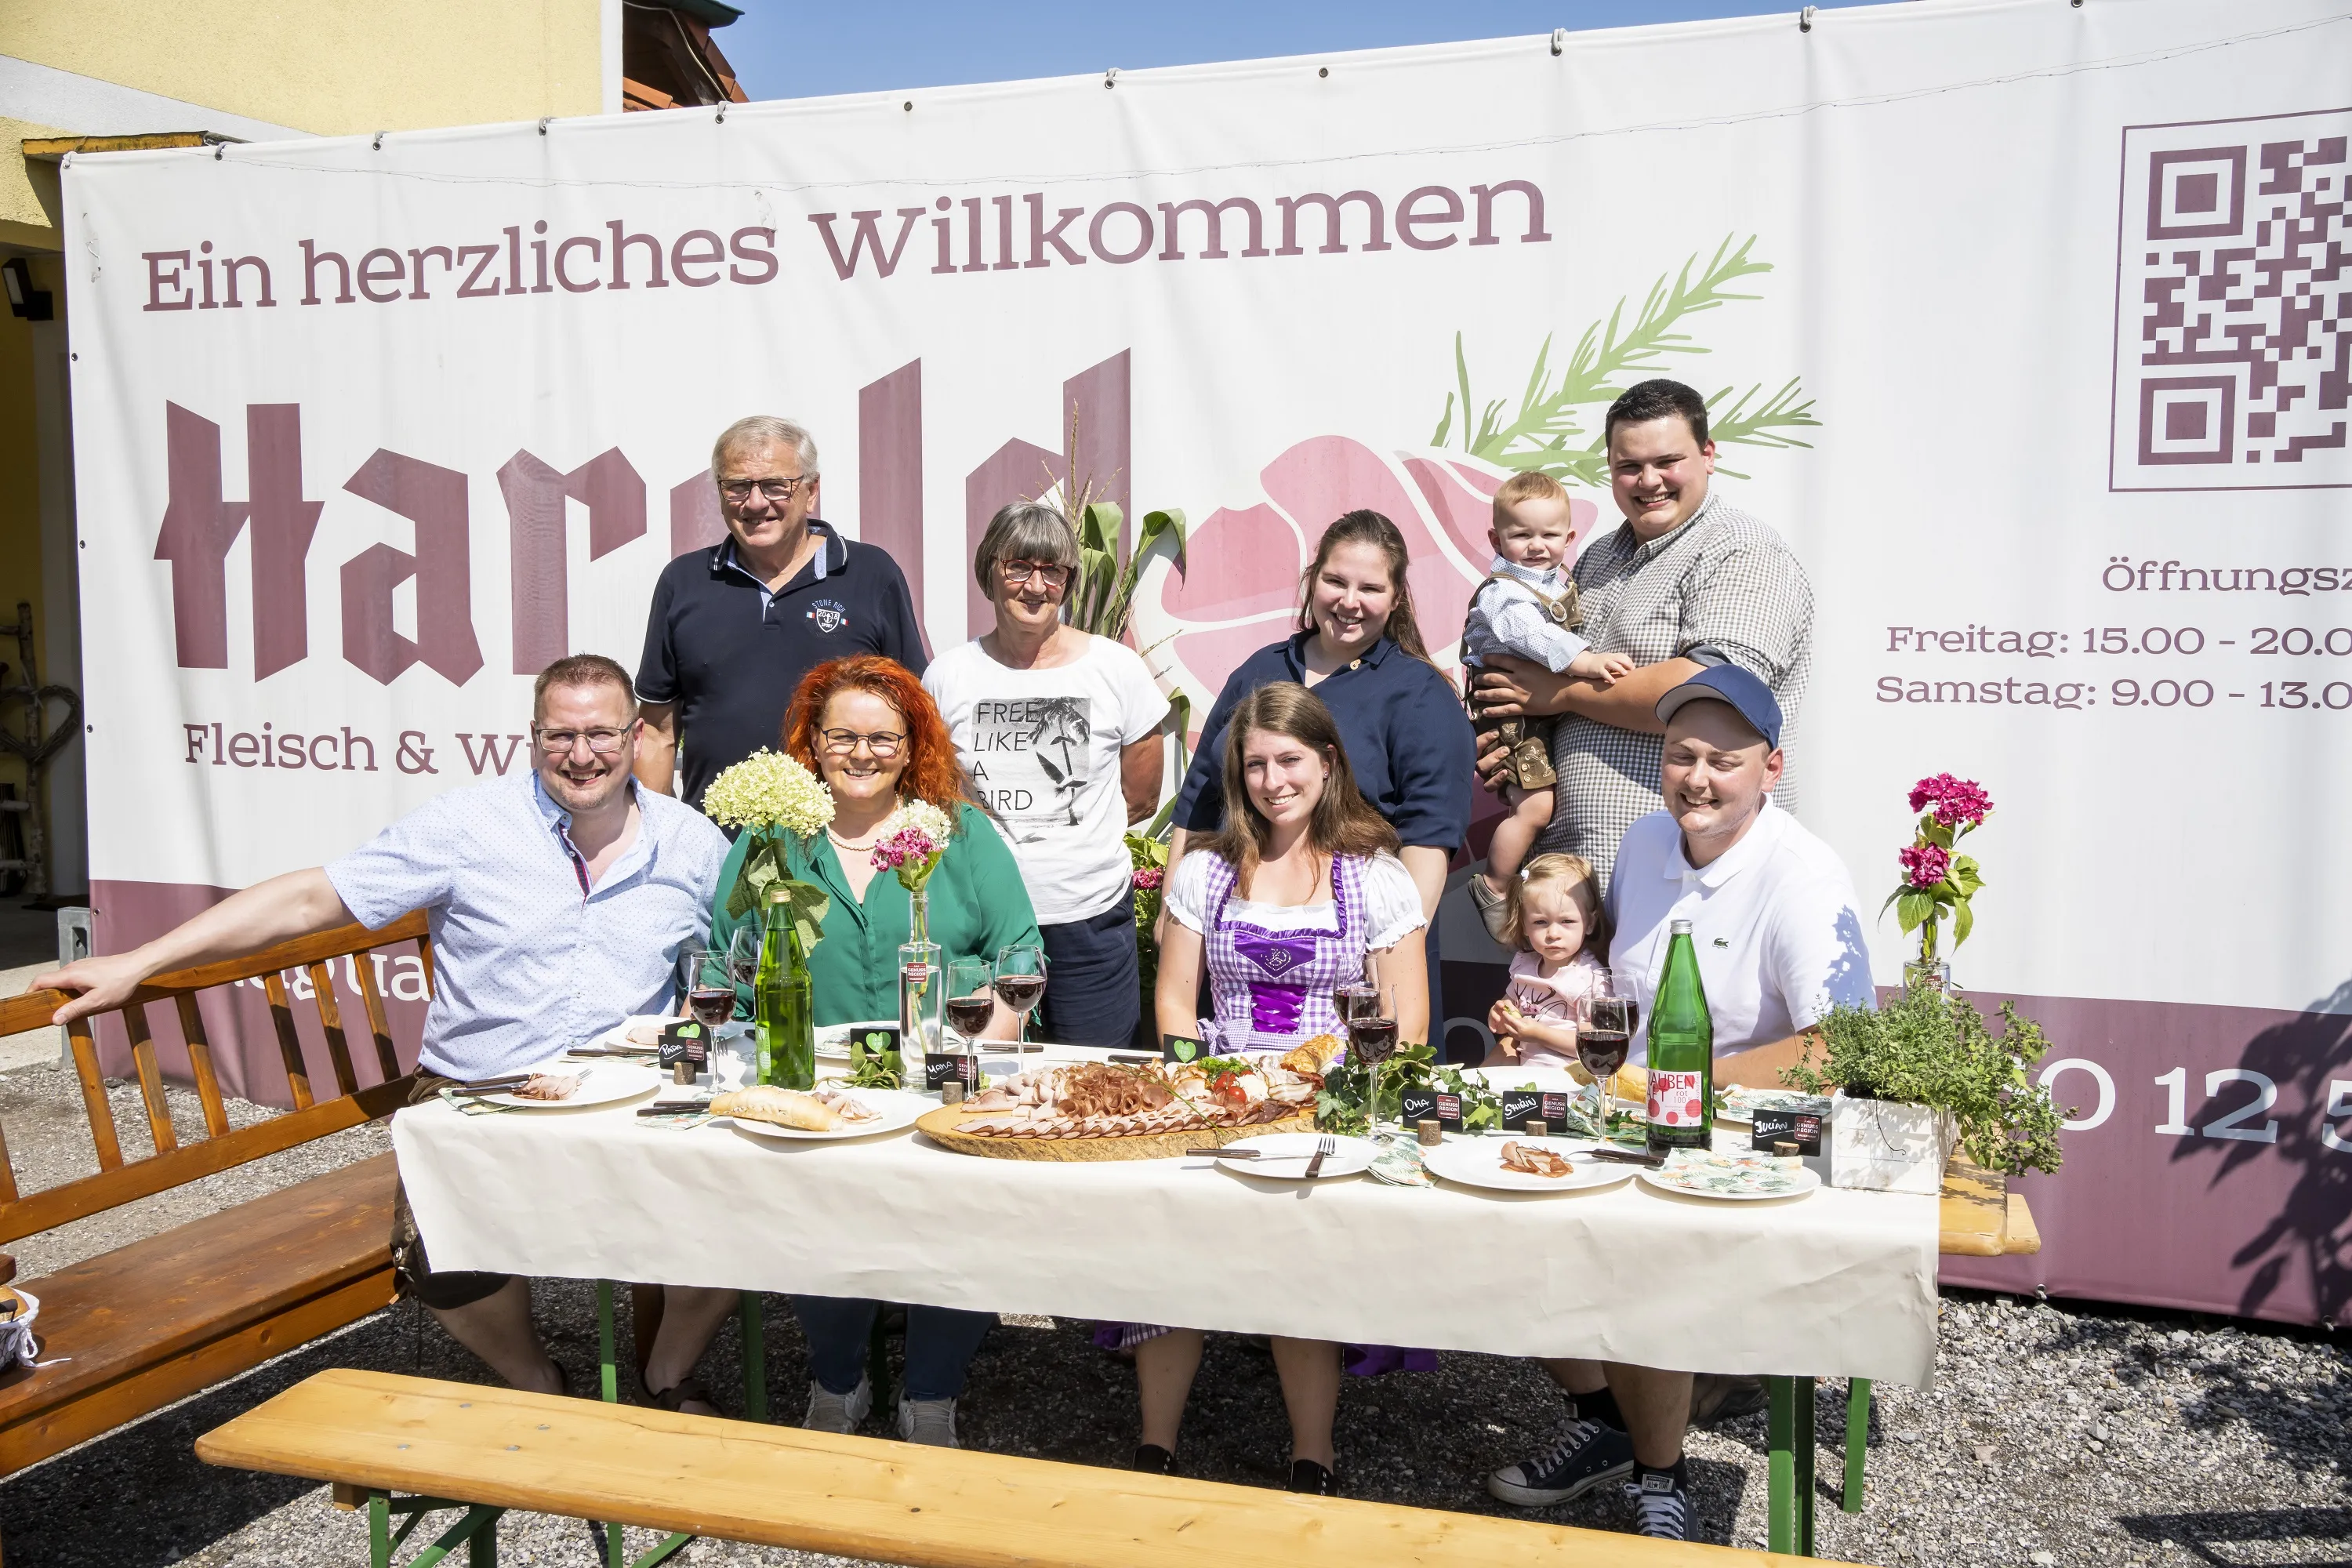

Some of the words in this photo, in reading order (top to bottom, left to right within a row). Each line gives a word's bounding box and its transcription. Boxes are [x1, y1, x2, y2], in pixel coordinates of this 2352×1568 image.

[142, 241, 276, 311] Ein
[299, 220, 779, 305] herzliches
[808, 180, 1552, 281] Willkommen
[812, 599, 831, 608] STONE
[833, 601, 846, 613] RICH
[1886, 624, 2068, 658] Freitag:
[2083, 627, 2205, 655] 15.00
[1876, 677, 2096, 710] Samstag:
[2111, 679, 2214, 706] 9.00
[978, 701, 1040, 723] FREE
[183, 721, 379, 771] Fleisch
[395, 731, 439, 775] &
[974, 731, 1028, 751] LIKE
[973, 760, 989, 781] A
[977, 789, 1033, 811] BIRD
[1404, 1098, 1429, 1111] OMA
[2154, 1066, 2279, 1143] 12
